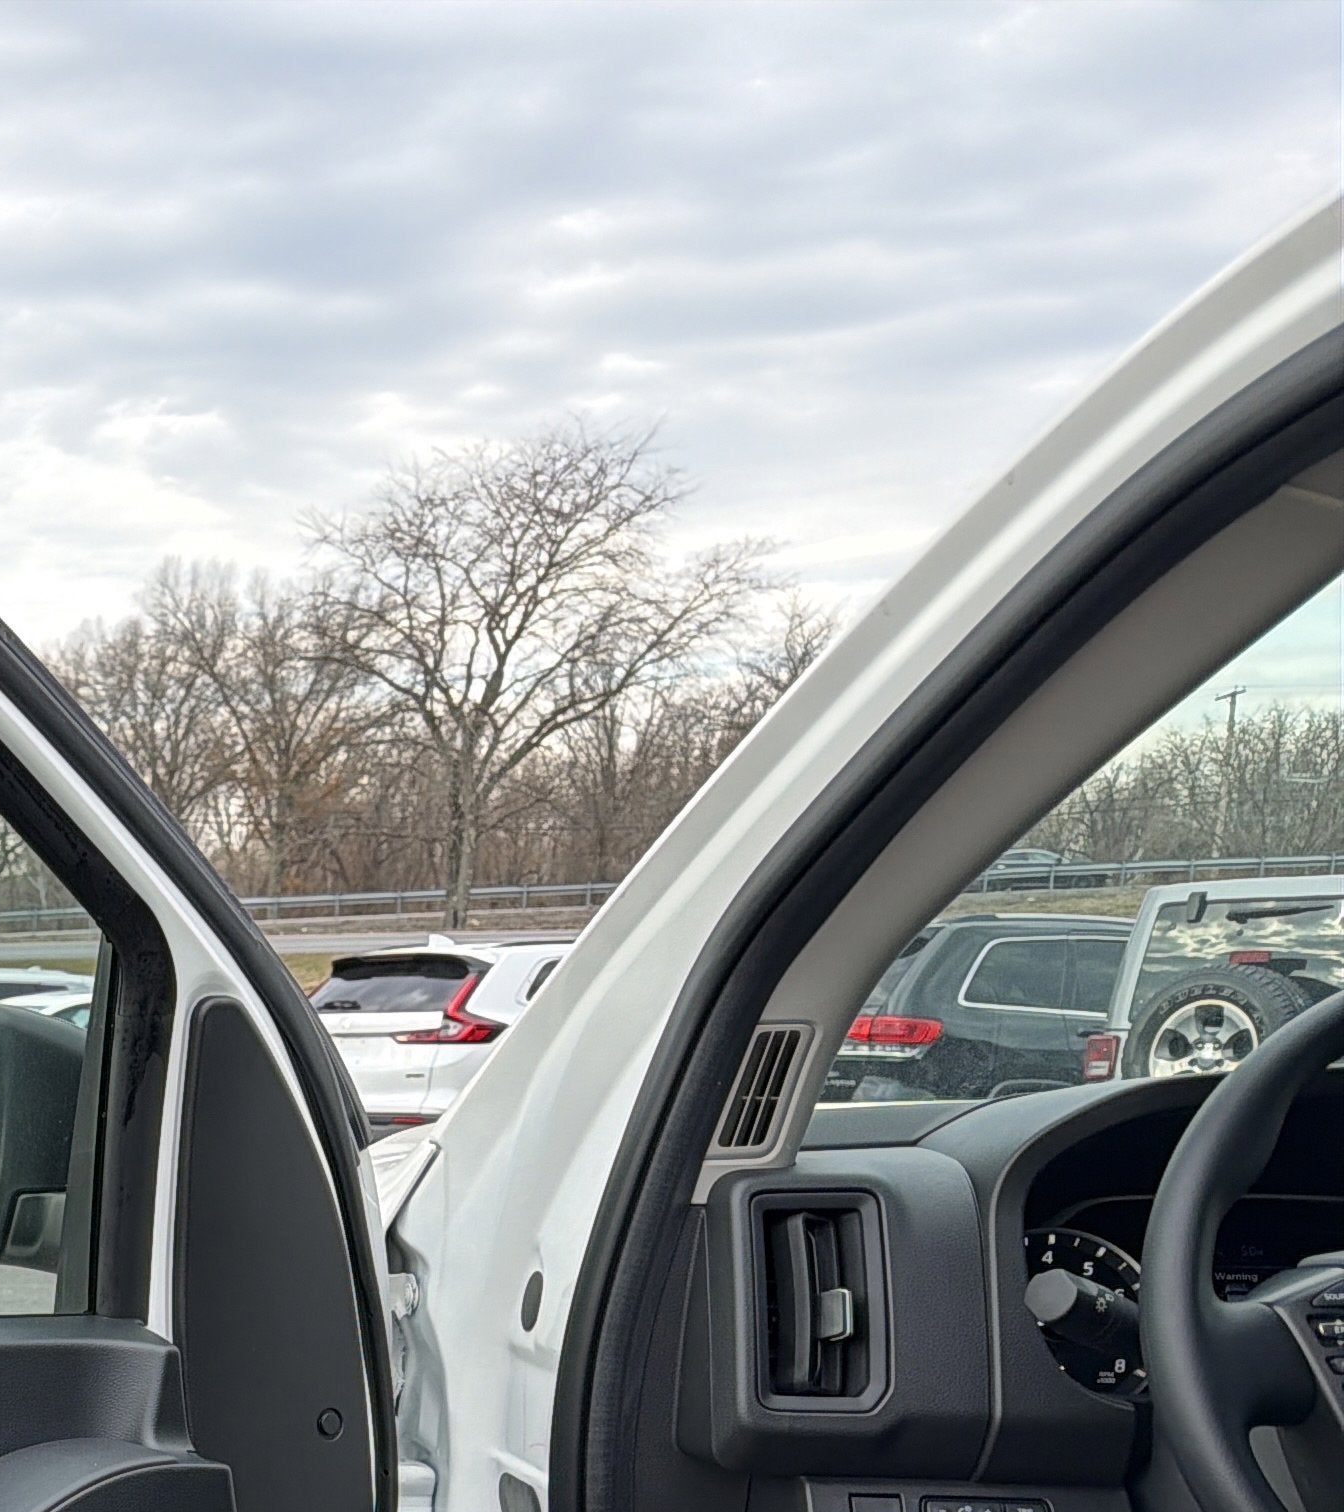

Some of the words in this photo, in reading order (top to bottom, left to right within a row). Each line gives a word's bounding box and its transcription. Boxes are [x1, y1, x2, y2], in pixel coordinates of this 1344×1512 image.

[1041, 1251, 1053, 1264] 4
[1083, 1262, 1094, 1276] 5
[1215, 1272, 1258, 1283] Warning
[1115, 1359, 1126, 1373] 8
